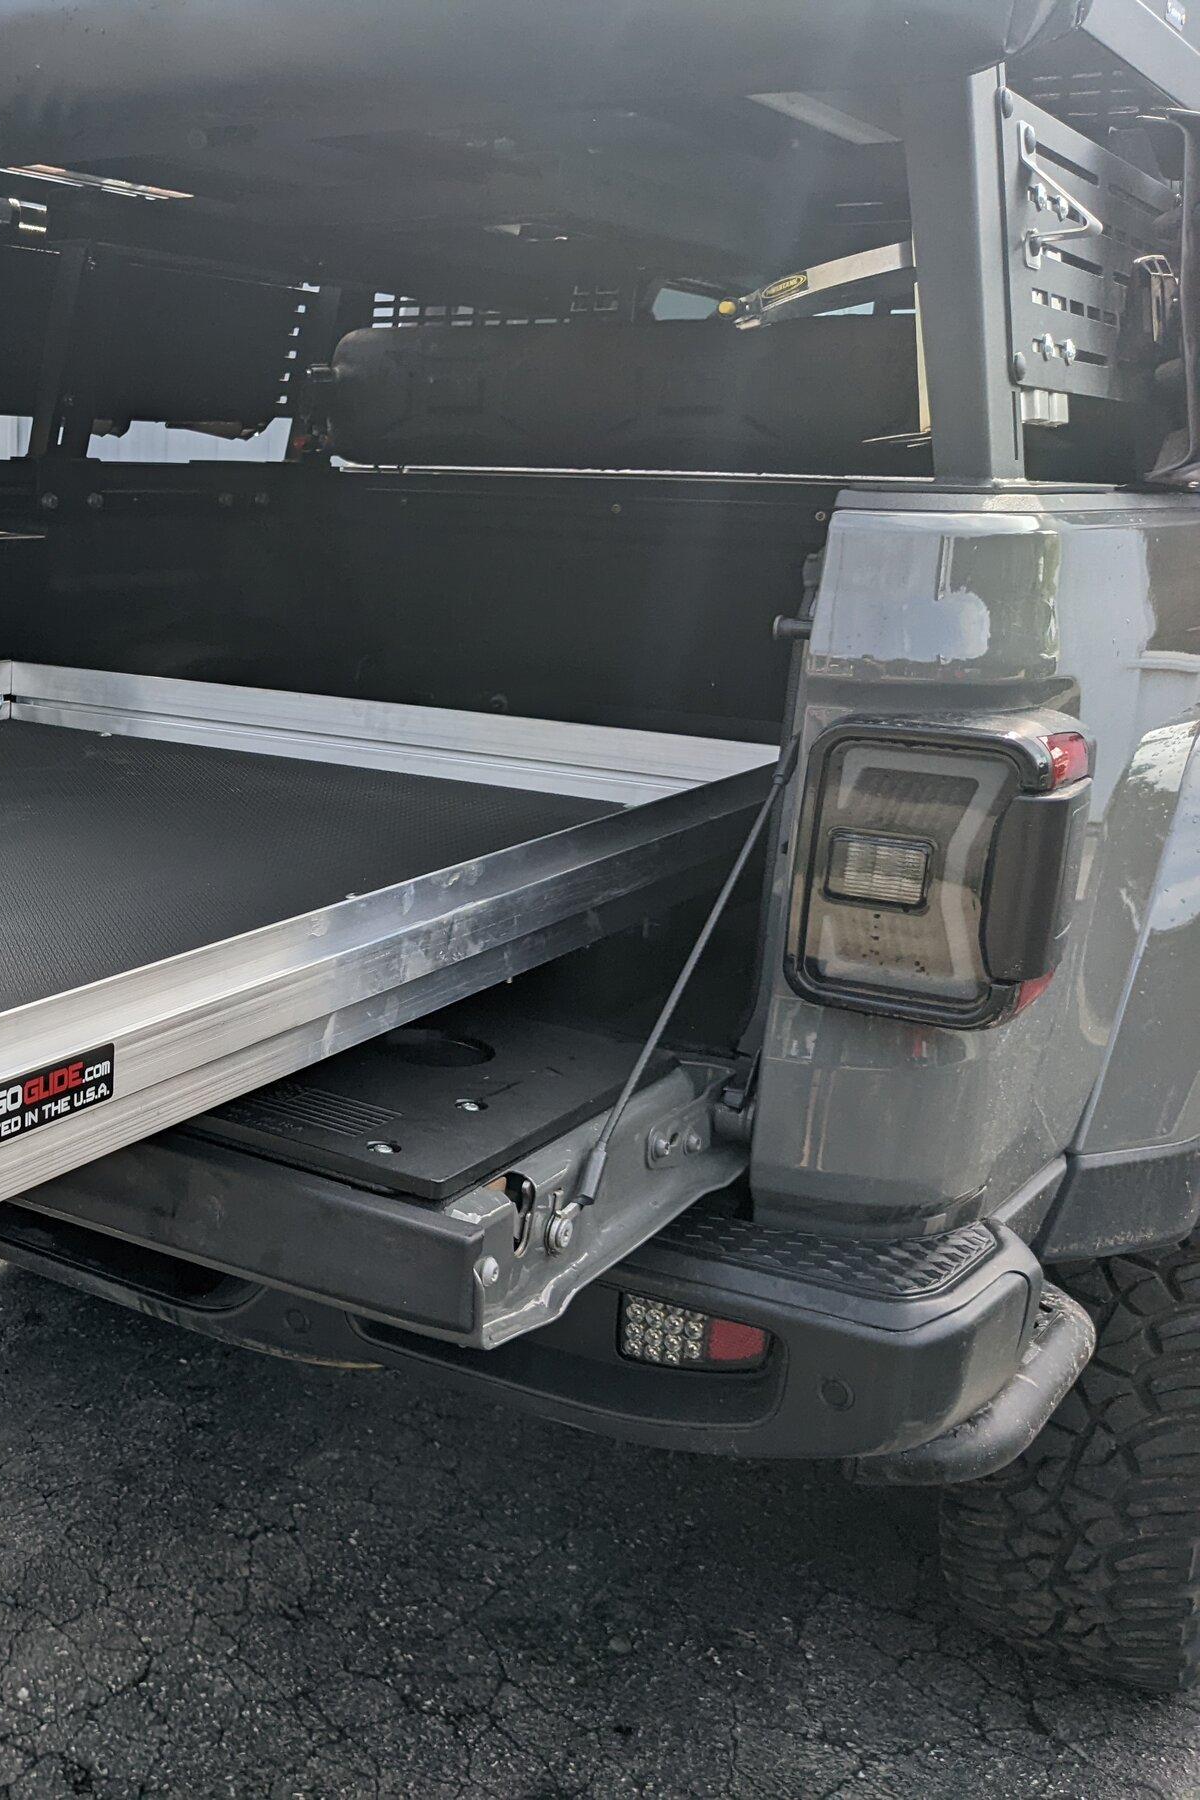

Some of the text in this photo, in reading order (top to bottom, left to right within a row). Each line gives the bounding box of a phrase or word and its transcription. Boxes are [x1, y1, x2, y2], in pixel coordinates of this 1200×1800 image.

[24, 1108, 39, 1128] IN
[42, 1095, 71, 1120] THE
[73, 1082, 110, 1108] U.S.A.
